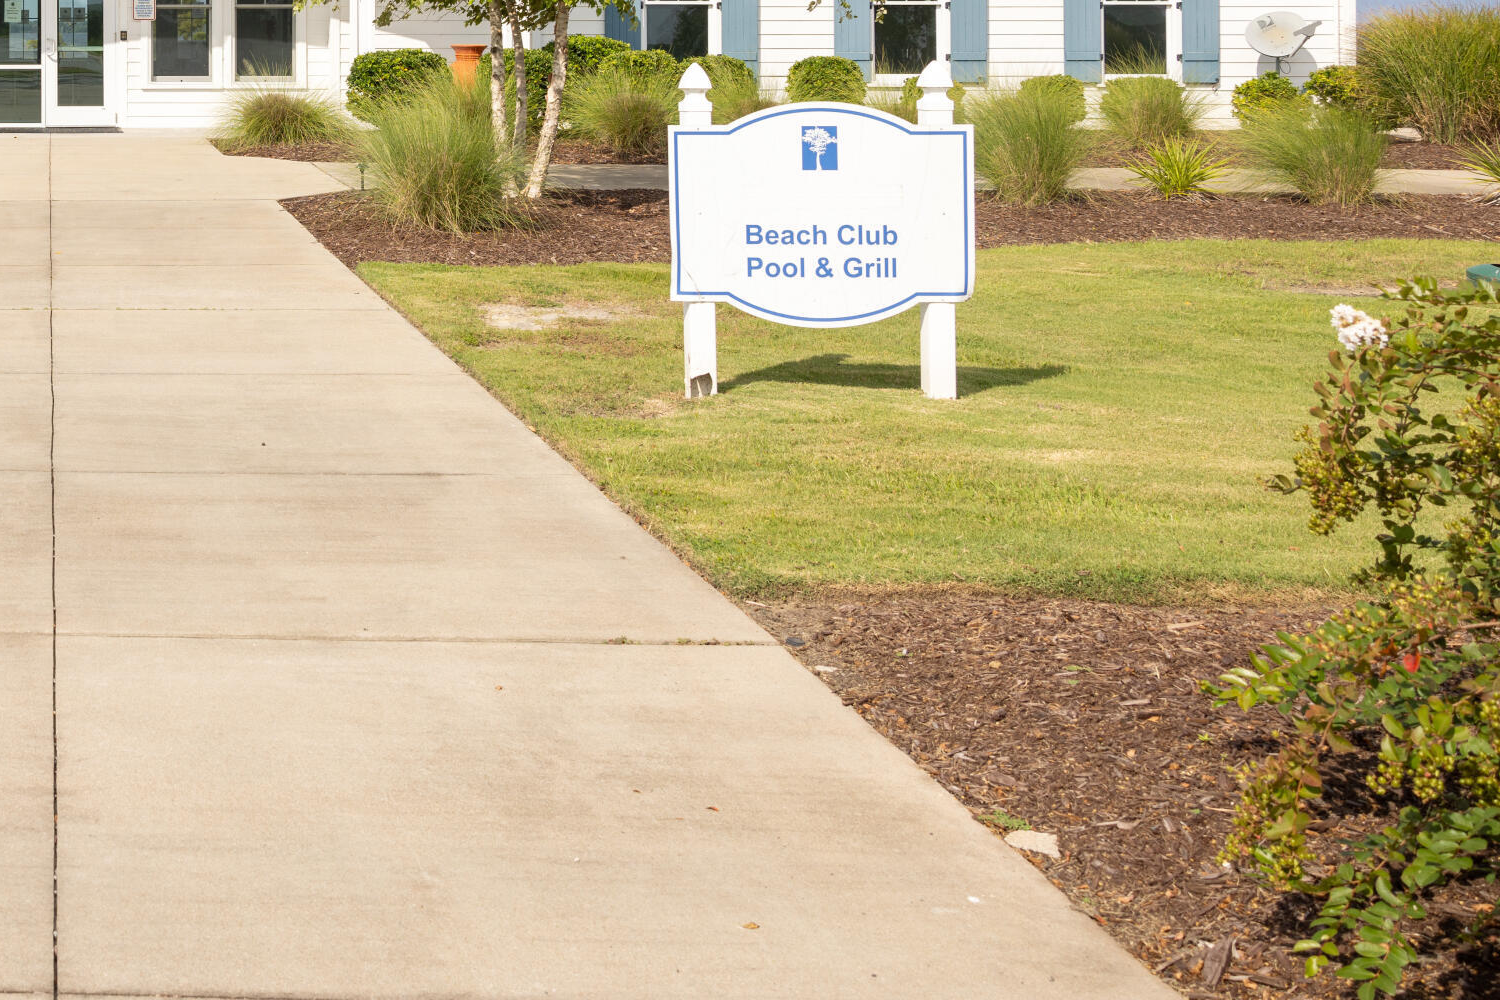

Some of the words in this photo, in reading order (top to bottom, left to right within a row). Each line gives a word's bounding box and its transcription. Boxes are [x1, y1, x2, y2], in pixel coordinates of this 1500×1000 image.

[745, 224, 827, 246] Beach
[837, 224, 898, 246] Club
[747, 256, 805, 278] Pool
[815, 257, 834, 278] &
[843, 256, 897, 279] Grill
